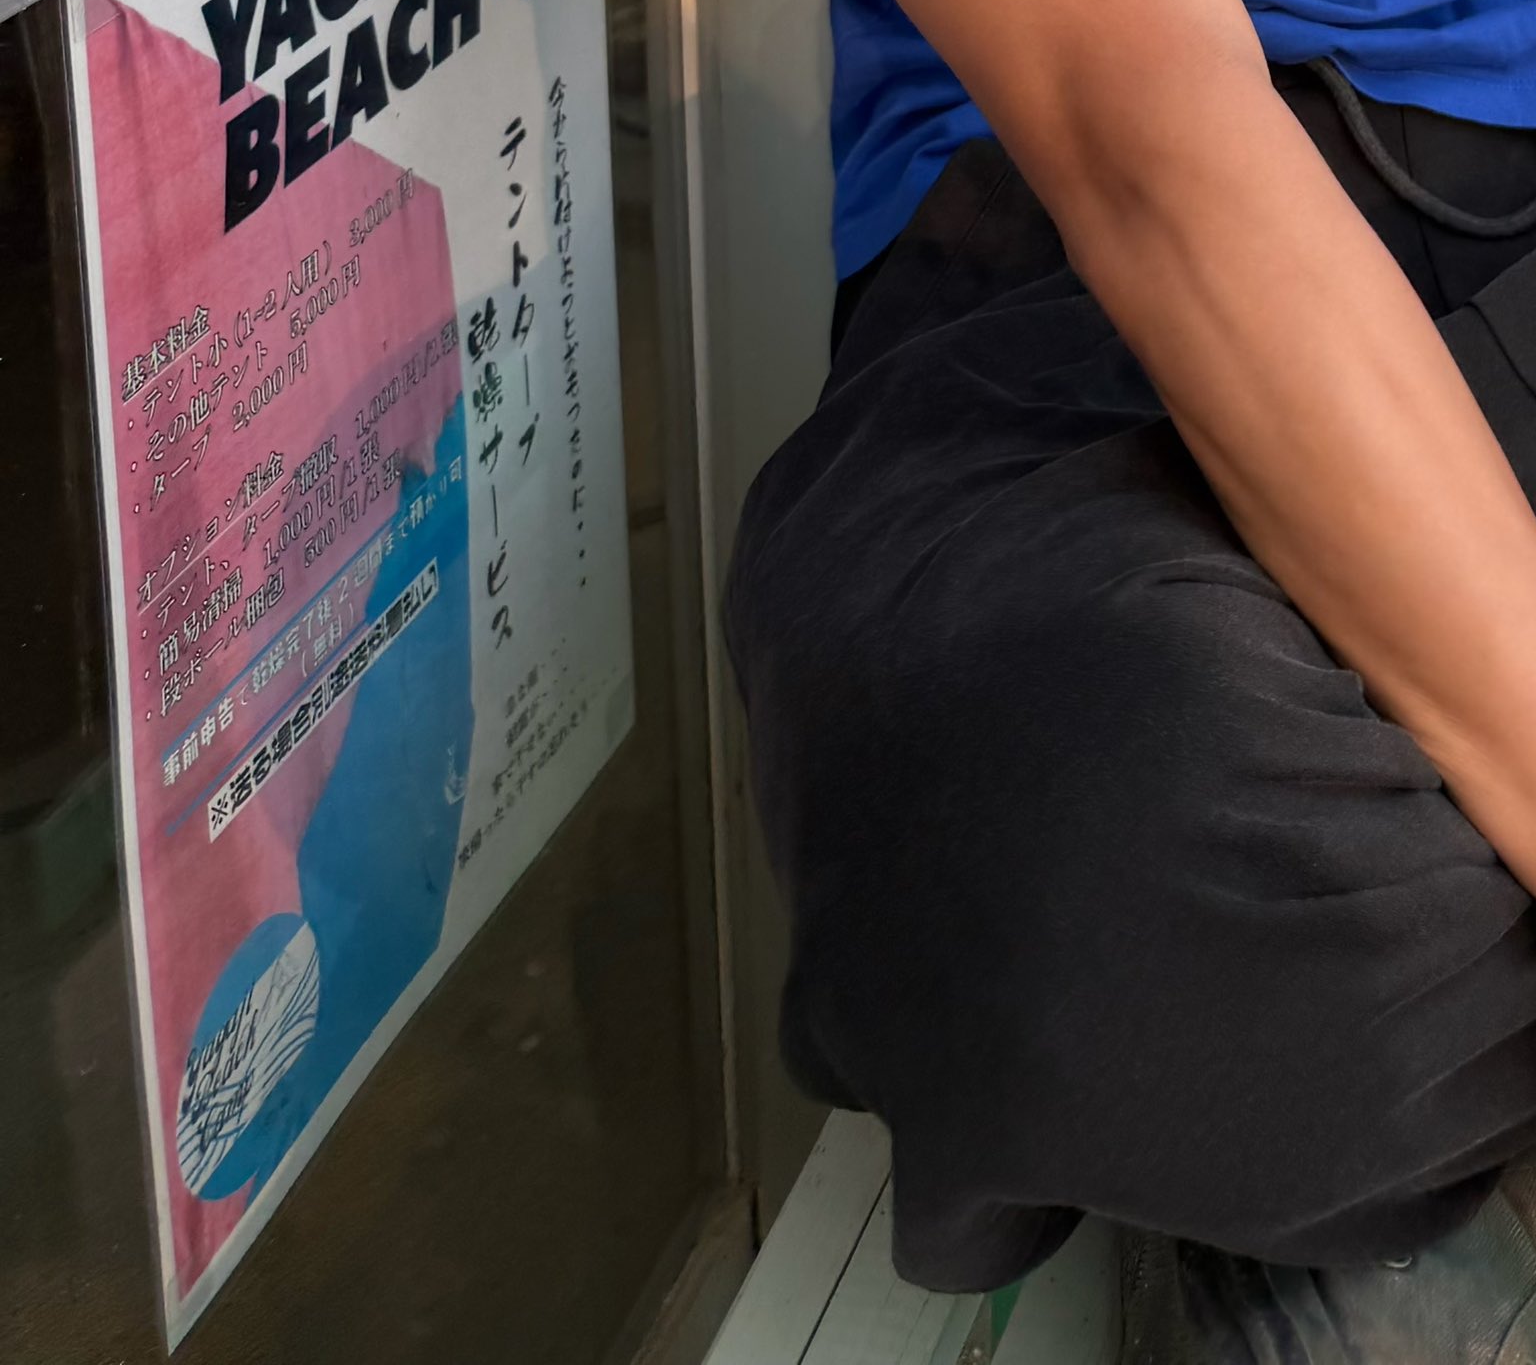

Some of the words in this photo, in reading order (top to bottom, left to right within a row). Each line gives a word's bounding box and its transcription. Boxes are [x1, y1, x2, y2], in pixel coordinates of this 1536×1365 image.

[121, 303, 210, 399] 基本料金
[499, 115, 540, 469] テントタープ
[137, 450, 285, 602] オプション料金
[157, 566, 244, 676] 簡易清掃
